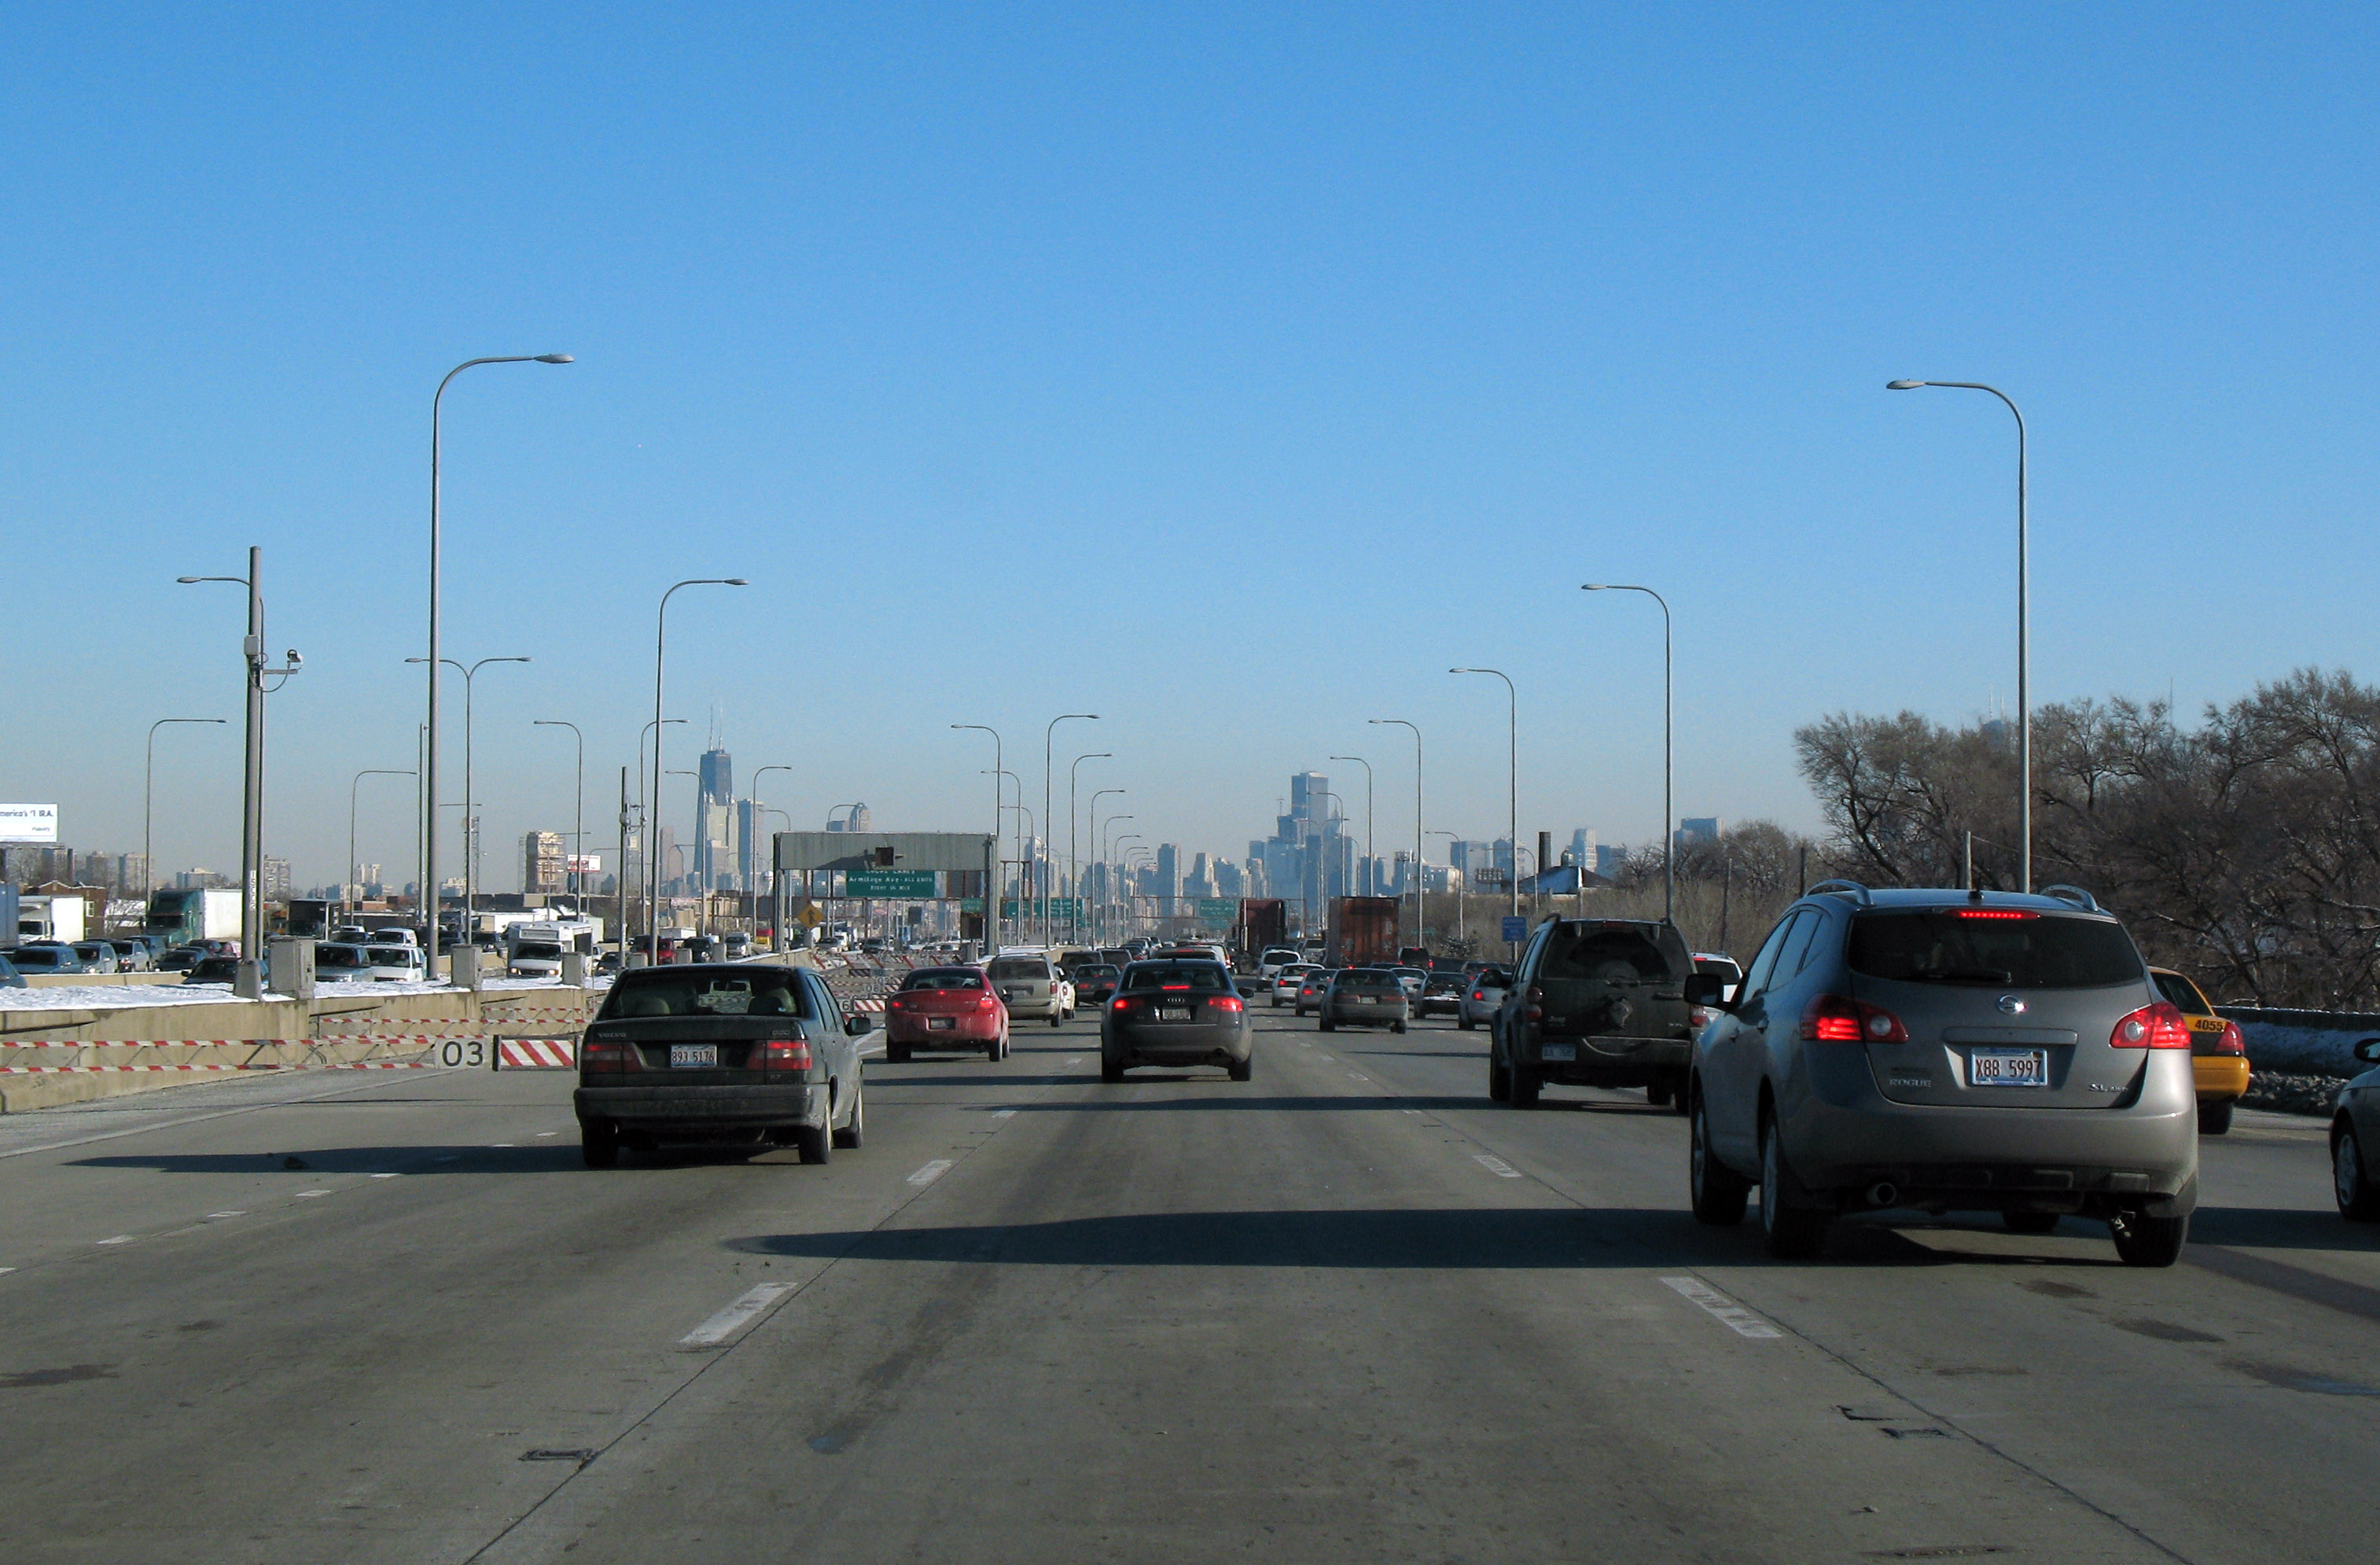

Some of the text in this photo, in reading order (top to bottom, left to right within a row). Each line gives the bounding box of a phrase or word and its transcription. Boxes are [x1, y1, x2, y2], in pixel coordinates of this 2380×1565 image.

[2195, 1019, 2224, 1031] 4055
[442, 1040, 484, 1066] 03
[671, 1051, 715, 1062] 893 5176
[1976, 1059, 2042, 1077] X88 5997
[1889, 1078, 1932, 1088] ROGUE
